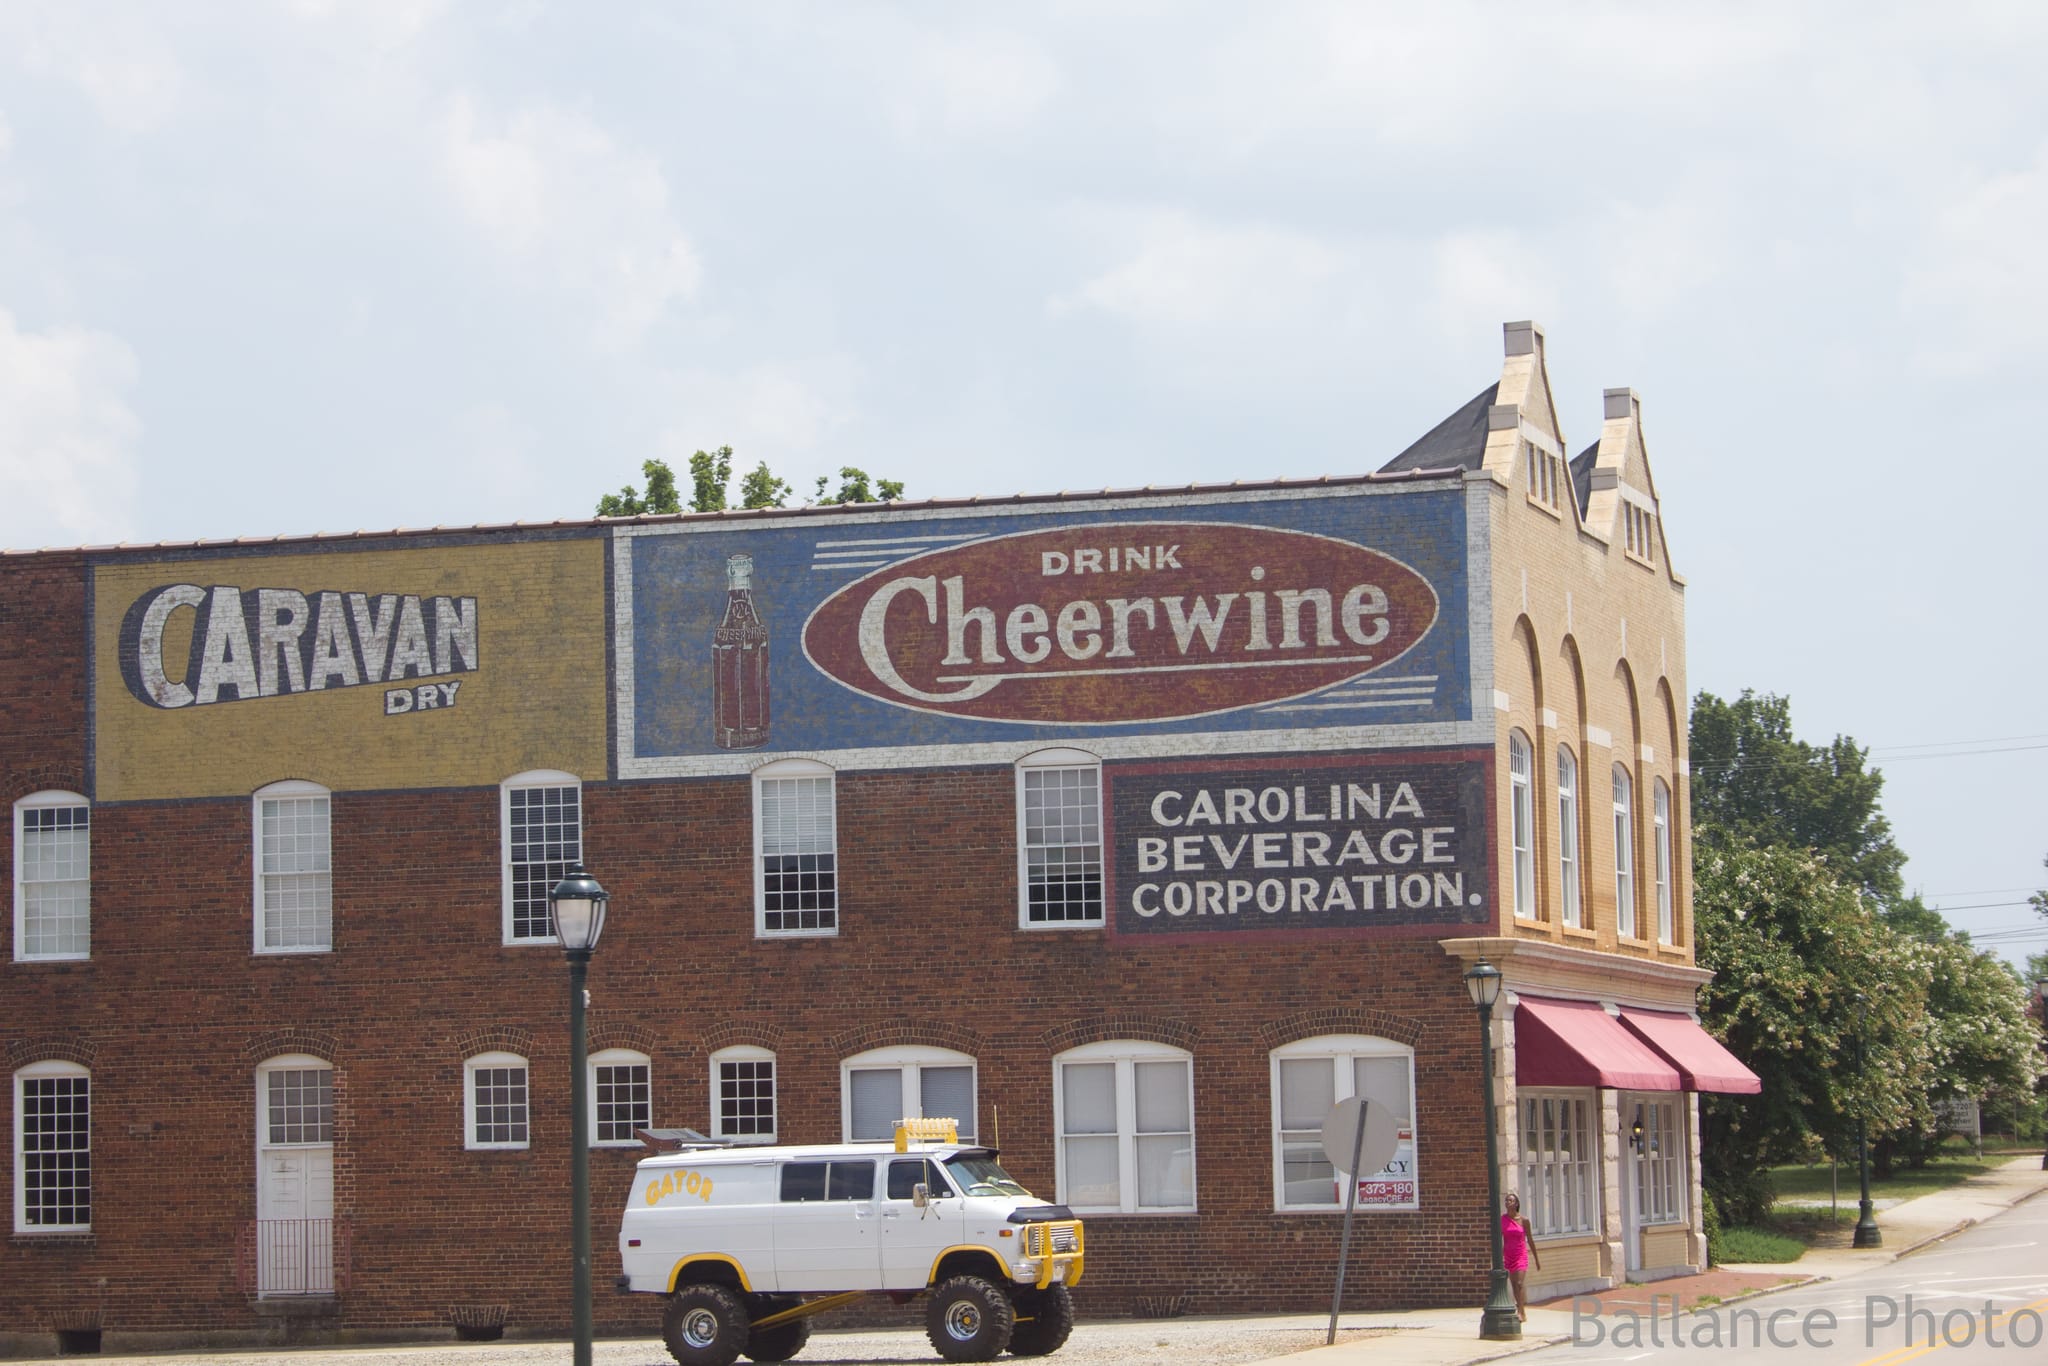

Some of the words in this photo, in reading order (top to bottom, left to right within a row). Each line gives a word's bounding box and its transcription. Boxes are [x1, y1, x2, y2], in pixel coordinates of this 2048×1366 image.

[1041, 544, 1182, 577] DRINK
[120, 583, 479, 709] CARAVAN
[858, 566, 1390, 702] Cheerwine
[385, 680, 462, 715] DRY
[1150, 781, 1425, 827] CAROLINA
[1137, 826, 1456, 873] BEVERAGE
[1131, 872, 1483, 917] CORPORATION.
[645, 1169, 713, 1206] GATOR
